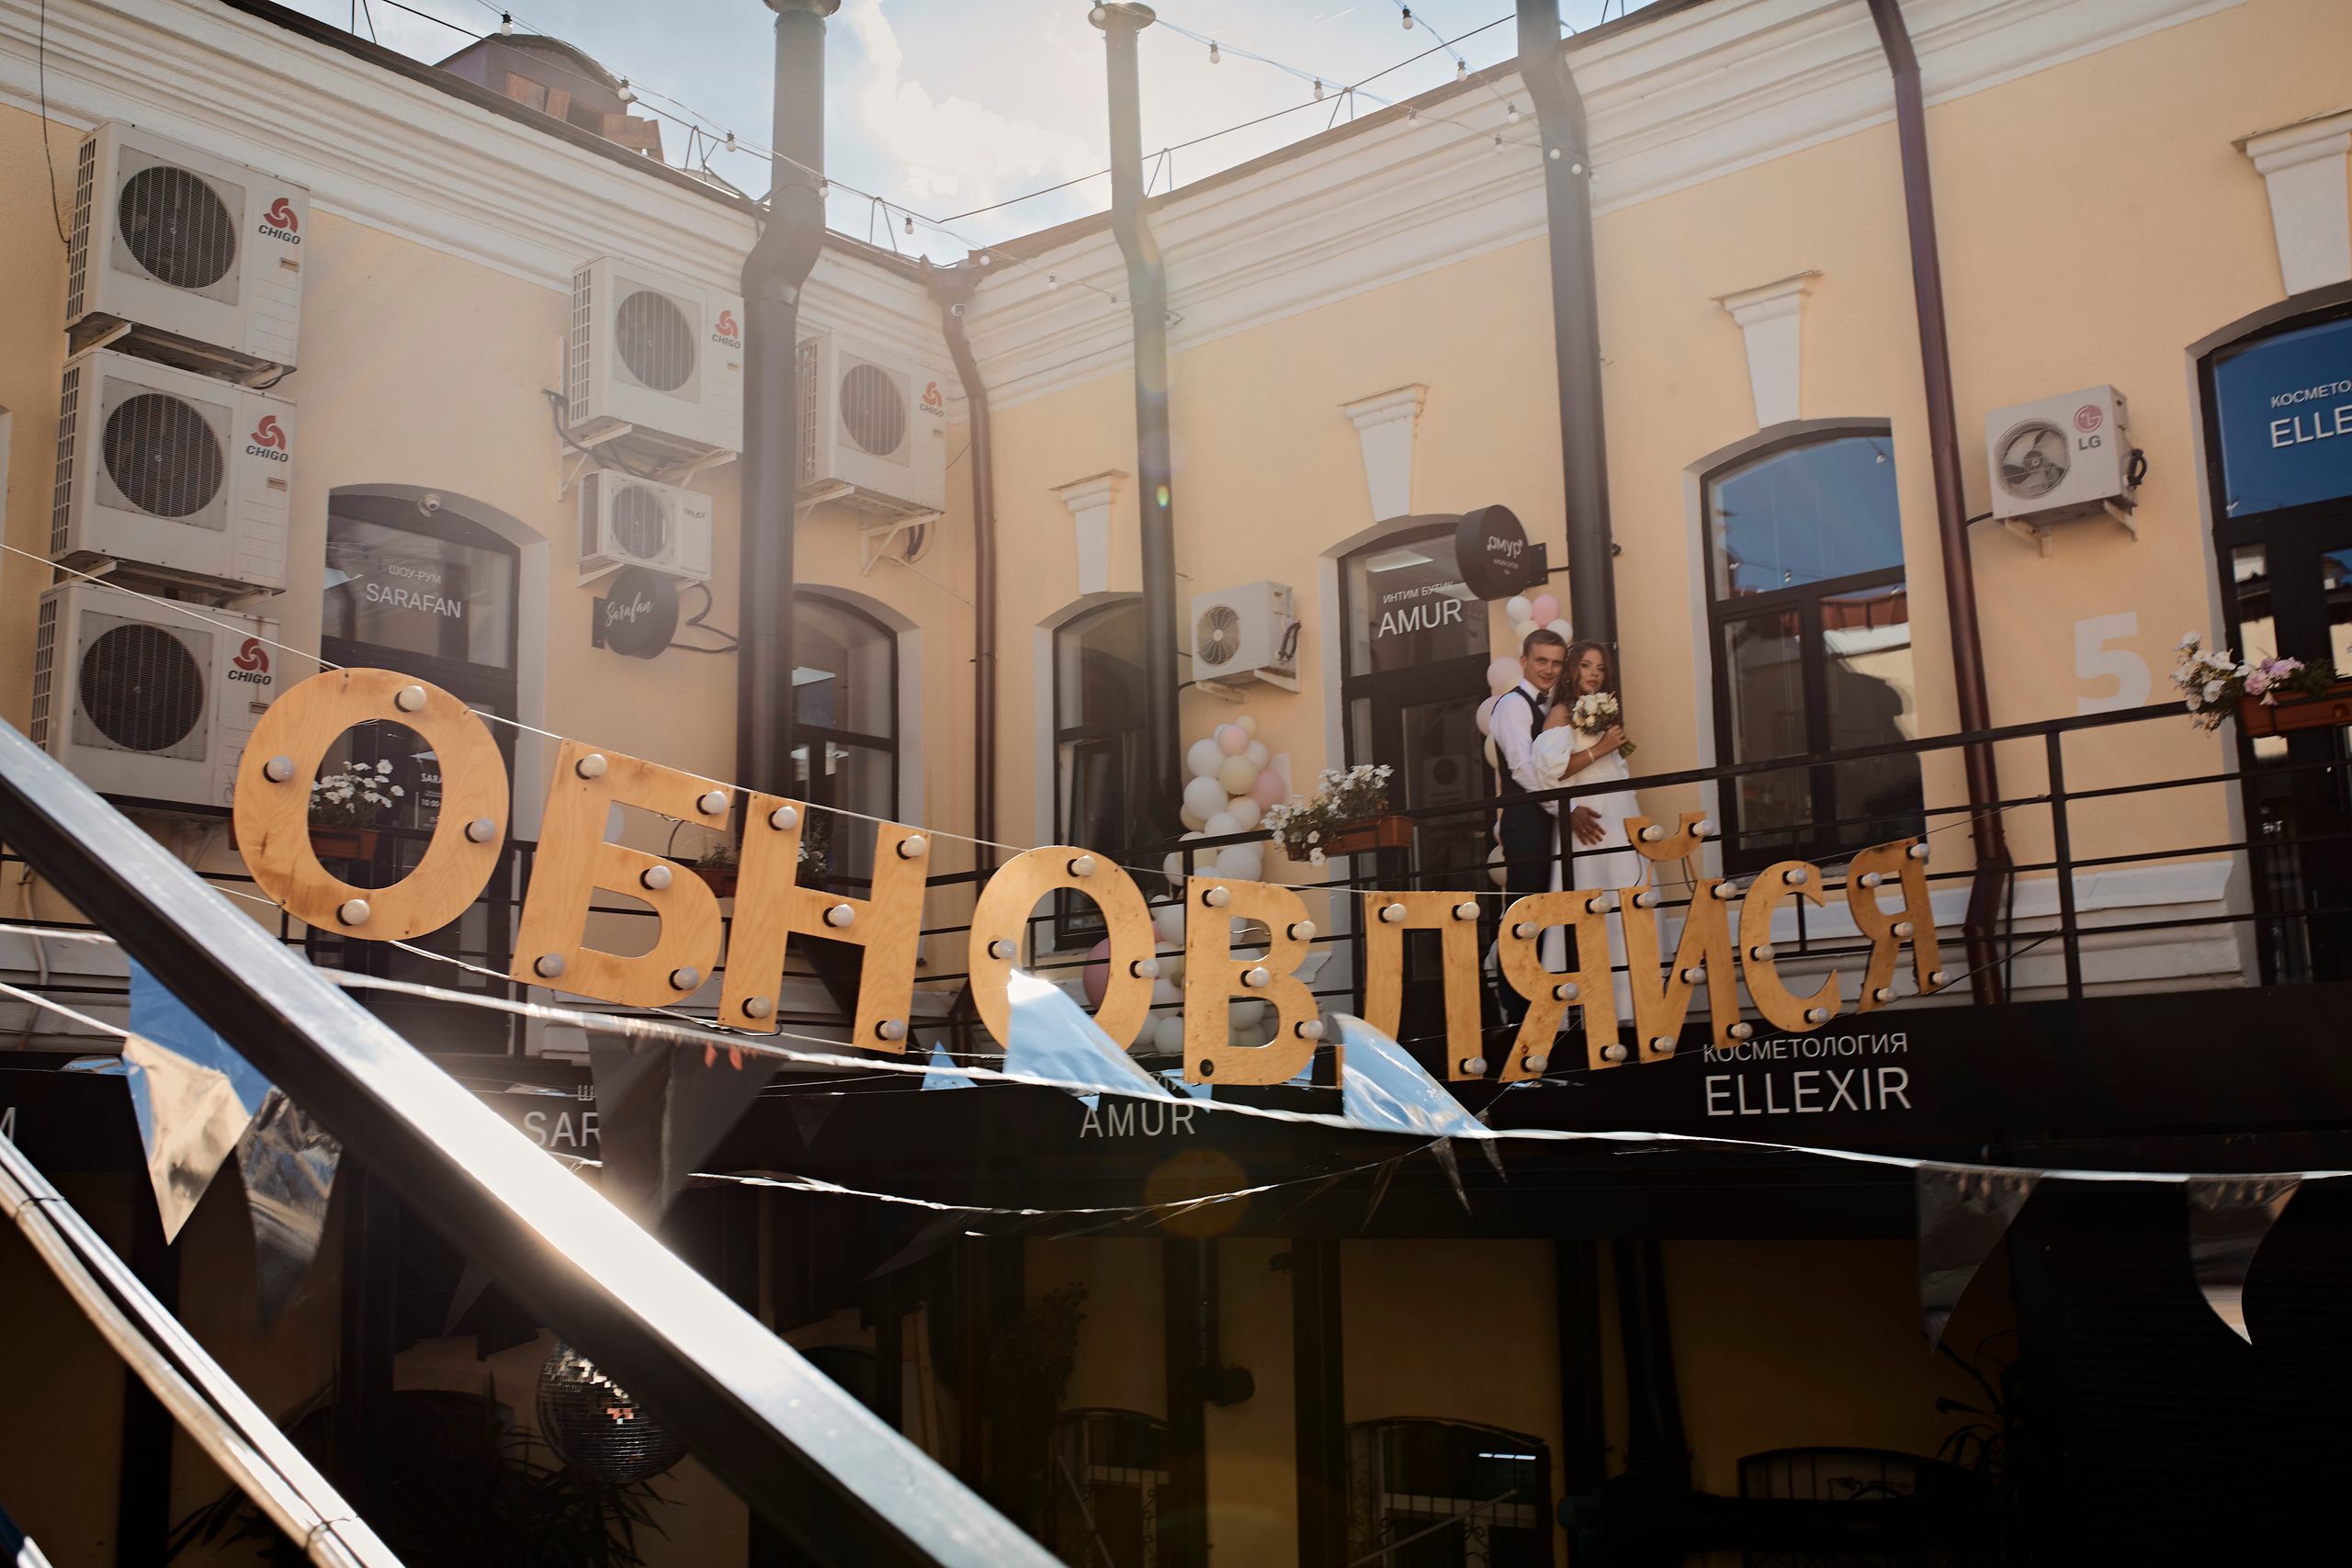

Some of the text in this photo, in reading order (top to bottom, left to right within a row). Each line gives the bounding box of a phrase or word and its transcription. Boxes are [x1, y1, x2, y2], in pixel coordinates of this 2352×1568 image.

[258, 224, 301, 245] CHIGO
[710, 333, 741, 350] CHIGO
[2270, 379, 2352, 409] КОСМЕТО
[919, 403, 945, 419] CHIGO
[2270, 404, 2352, 448] ELLE
[245, 445, 289, 464] CHIGO
[2078, 434, 2102, 451] LG
[389, 564, 441, 584] ШОУ-РУМ
[366, 582, 461, 619] SARAFAN
[605, 591, 654, 627] Sarafan
[1383, 588, 1419, 604] ИНТИМ
[1378, 598, 1464, 638] AMUR
[228, 669, 272, 685] CHIGO
[2074, 611, 2152, 716] 5
[420, 773, 443, 784] SARA
[233, 668, 1943, 1088] ОБНОВЛЯЙСЯ
[1703, 1032, 1908, 1063] КОСМЕТОЛОГИЯ
[1705, 1066, 1912, 1116] ELLEXIR
[524, 1111, 601, 1147] SAR
[1080, 1101, 1195, 1138] AMUR
